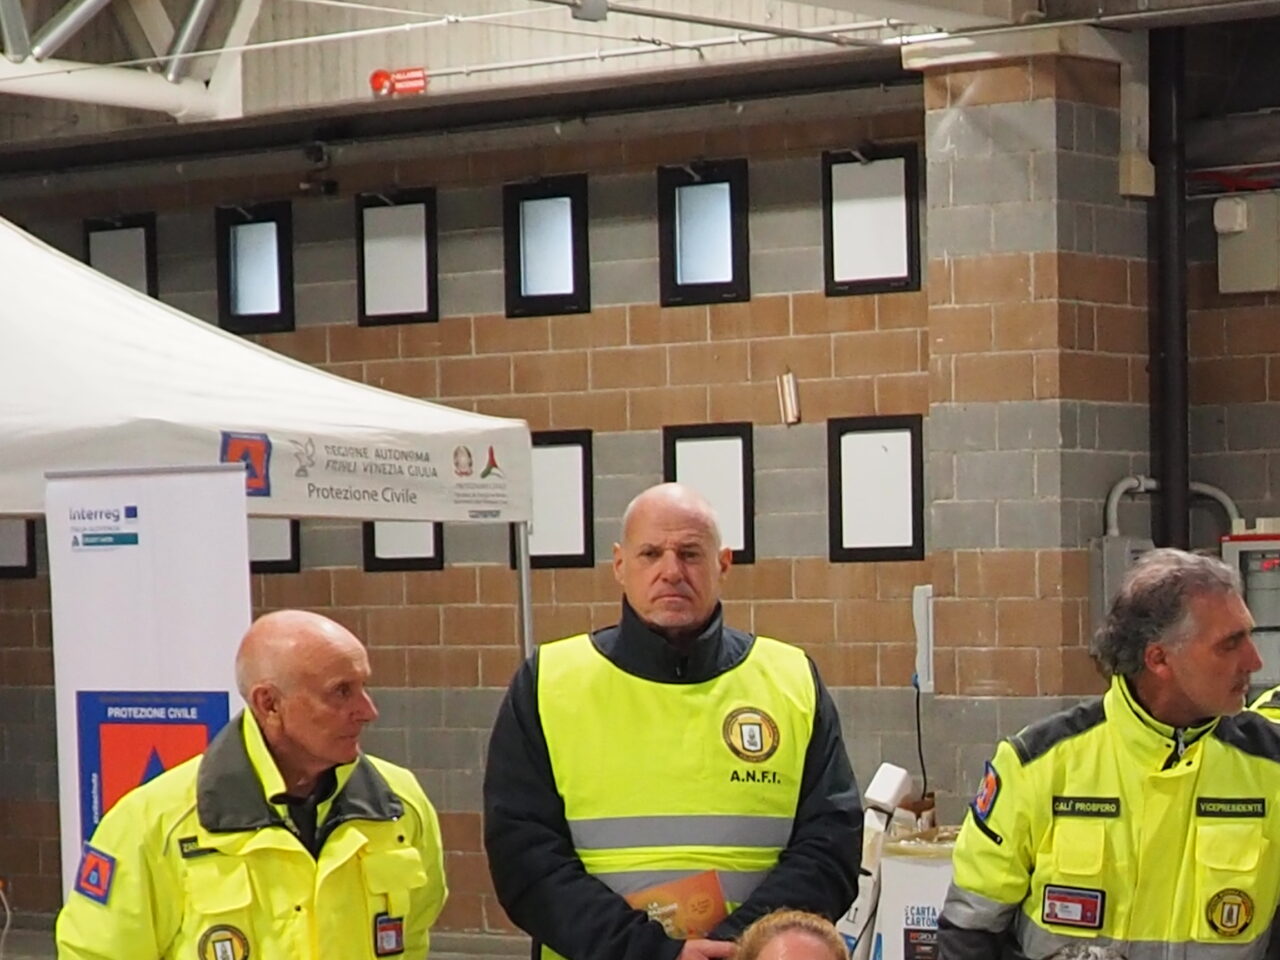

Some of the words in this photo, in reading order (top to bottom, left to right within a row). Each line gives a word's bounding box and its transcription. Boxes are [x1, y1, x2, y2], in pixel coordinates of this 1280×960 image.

[374, 446, 431, 463] AUTONOMA
[363, 461, 405, 476] VENEZIA
[408, 465, 438, 478] GIULIA
[307, 483, 380, 502] Protezione
[381, 487, 418, 504] Civile
[107, 707, 166, 719] PROTEZIONE
[167, 707, 198, 719] CIVILE
[730, 770, 781, 785] A.N.F.I.
[904, 916, 938, 928] CARTON
